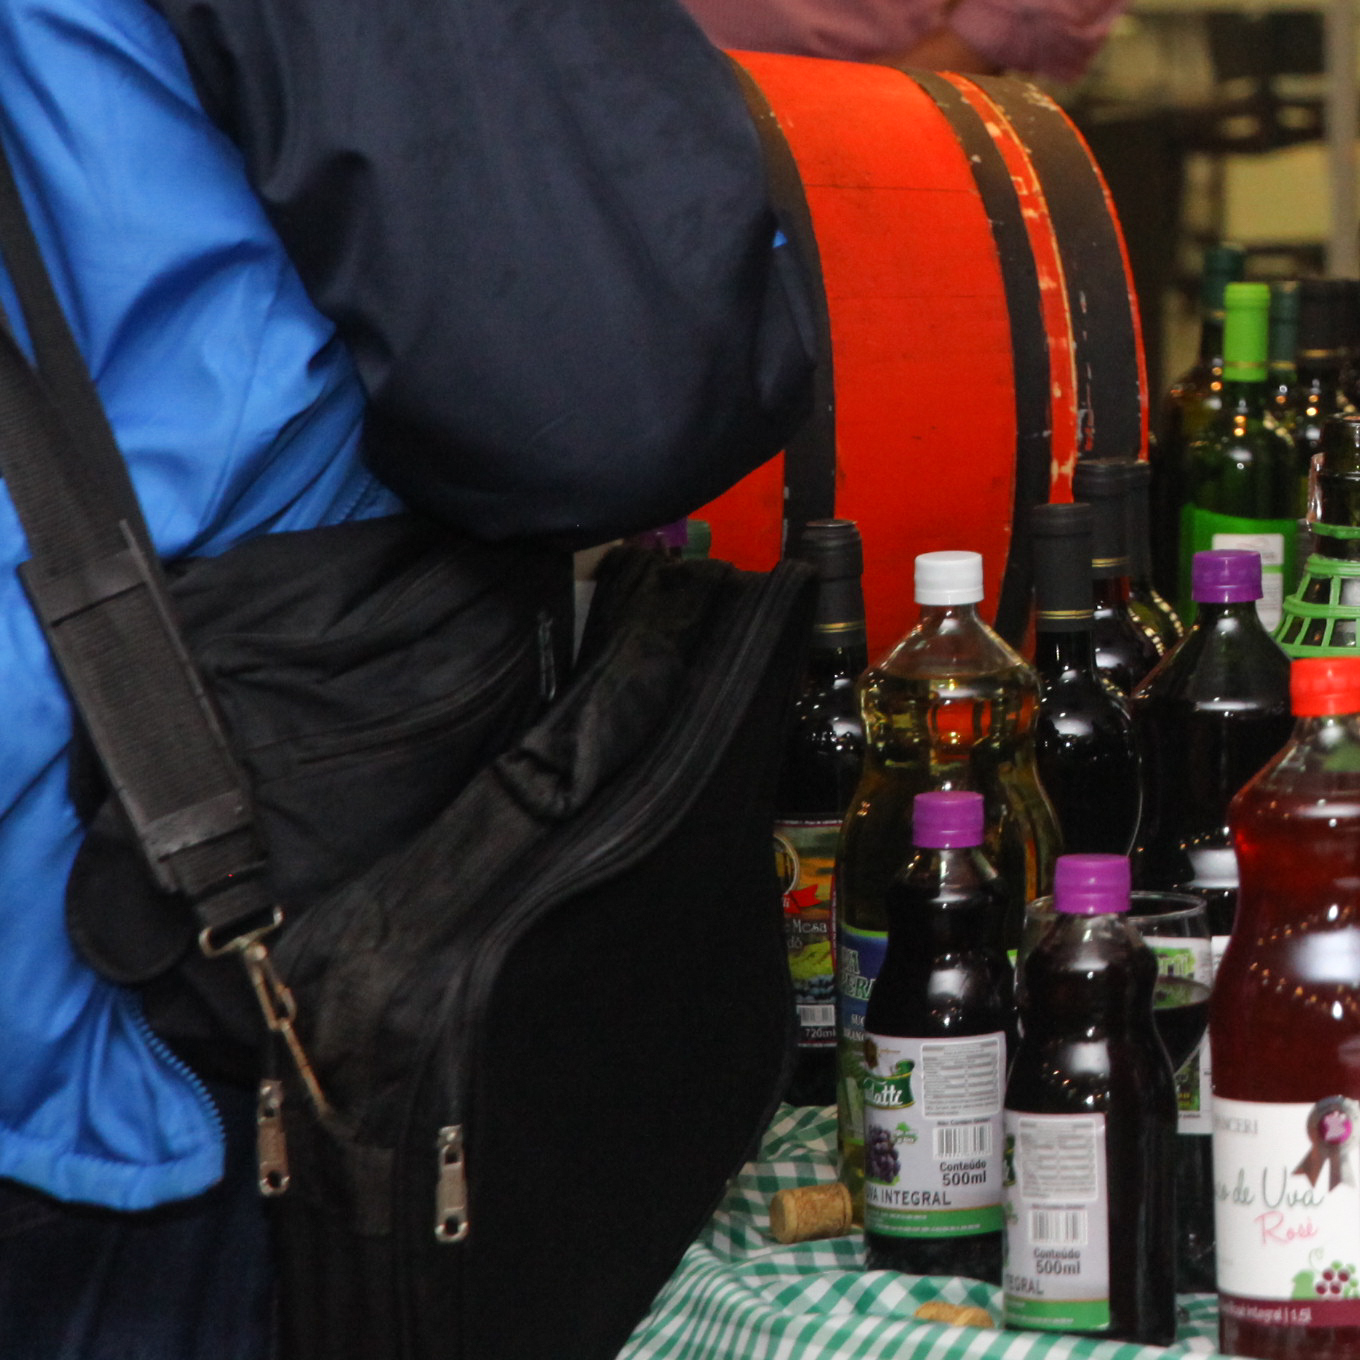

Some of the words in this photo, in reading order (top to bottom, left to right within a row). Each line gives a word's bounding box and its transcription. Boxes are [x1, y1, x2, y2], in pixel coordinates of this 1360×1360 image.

[940, 1158, 987, 1173] Conteúdo
[942, 1171, 988, 1186] 500ml
[1261, 1165, 1325, 1210] Uva
[881, 1190, 952, 1206] INTEGRAL
[1036, 1259, 1081, 1275] 500ml
